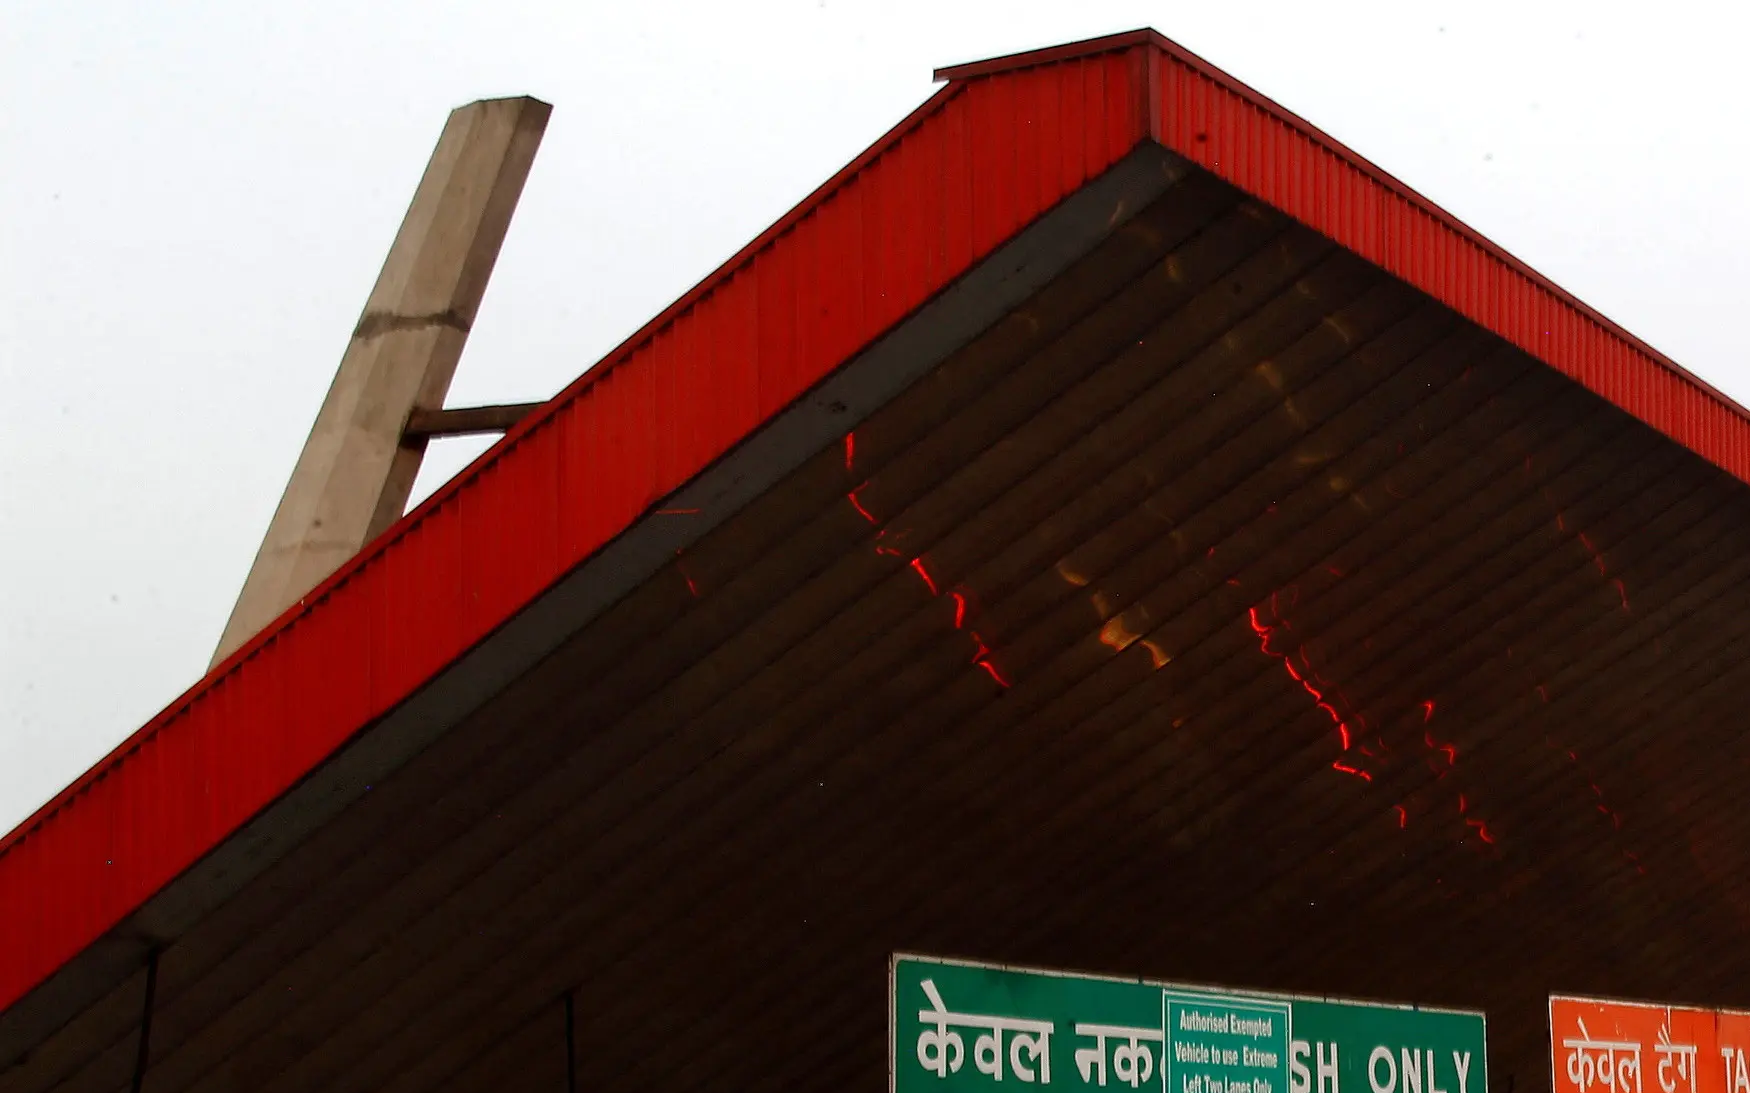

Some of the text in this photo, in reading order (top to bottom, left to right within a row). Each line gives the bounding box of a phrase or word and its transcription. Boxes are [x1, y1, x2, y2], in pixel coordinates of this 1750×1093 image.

[917, 978, 1163, 1089] केवल नक
[1179, 1009, 1272, 1041] Authorised Exempted
[1175, 1041, 1278, 1069] Vehicle to use Extreme
